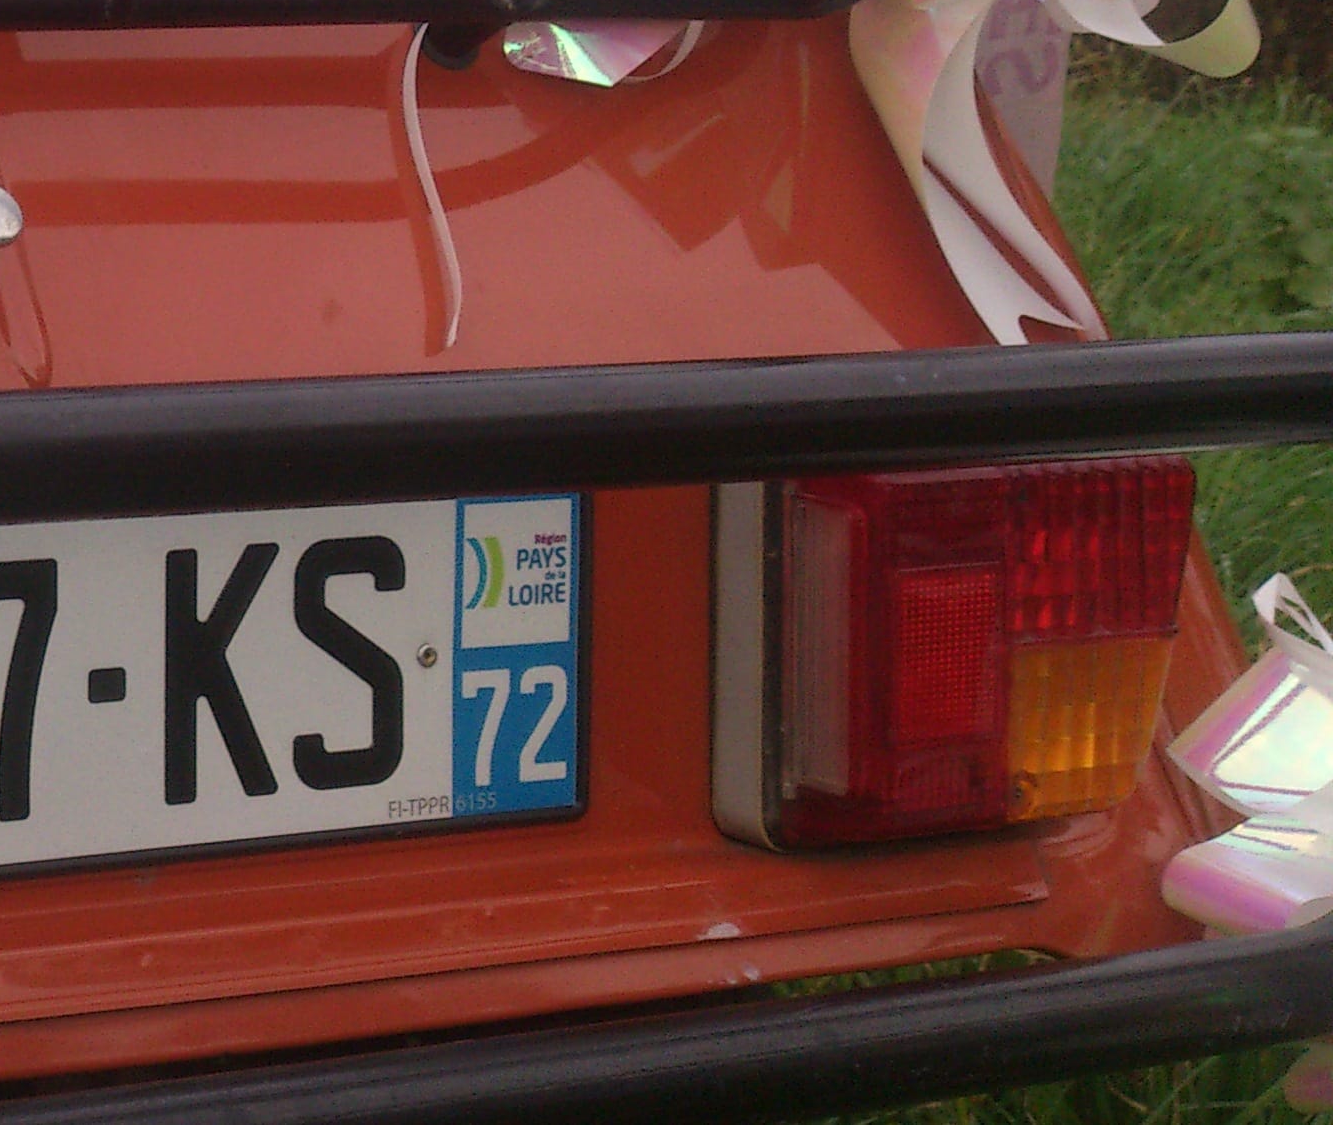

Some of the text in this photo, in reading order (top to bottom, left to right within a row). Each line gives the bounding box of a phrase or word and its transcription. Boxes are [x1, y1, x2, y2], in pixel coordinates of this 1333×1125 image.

[516, 546, 567, 571] PAYS
[508, 581, 566, 607] LOIRE
[461, 664, 568, 787] 72
